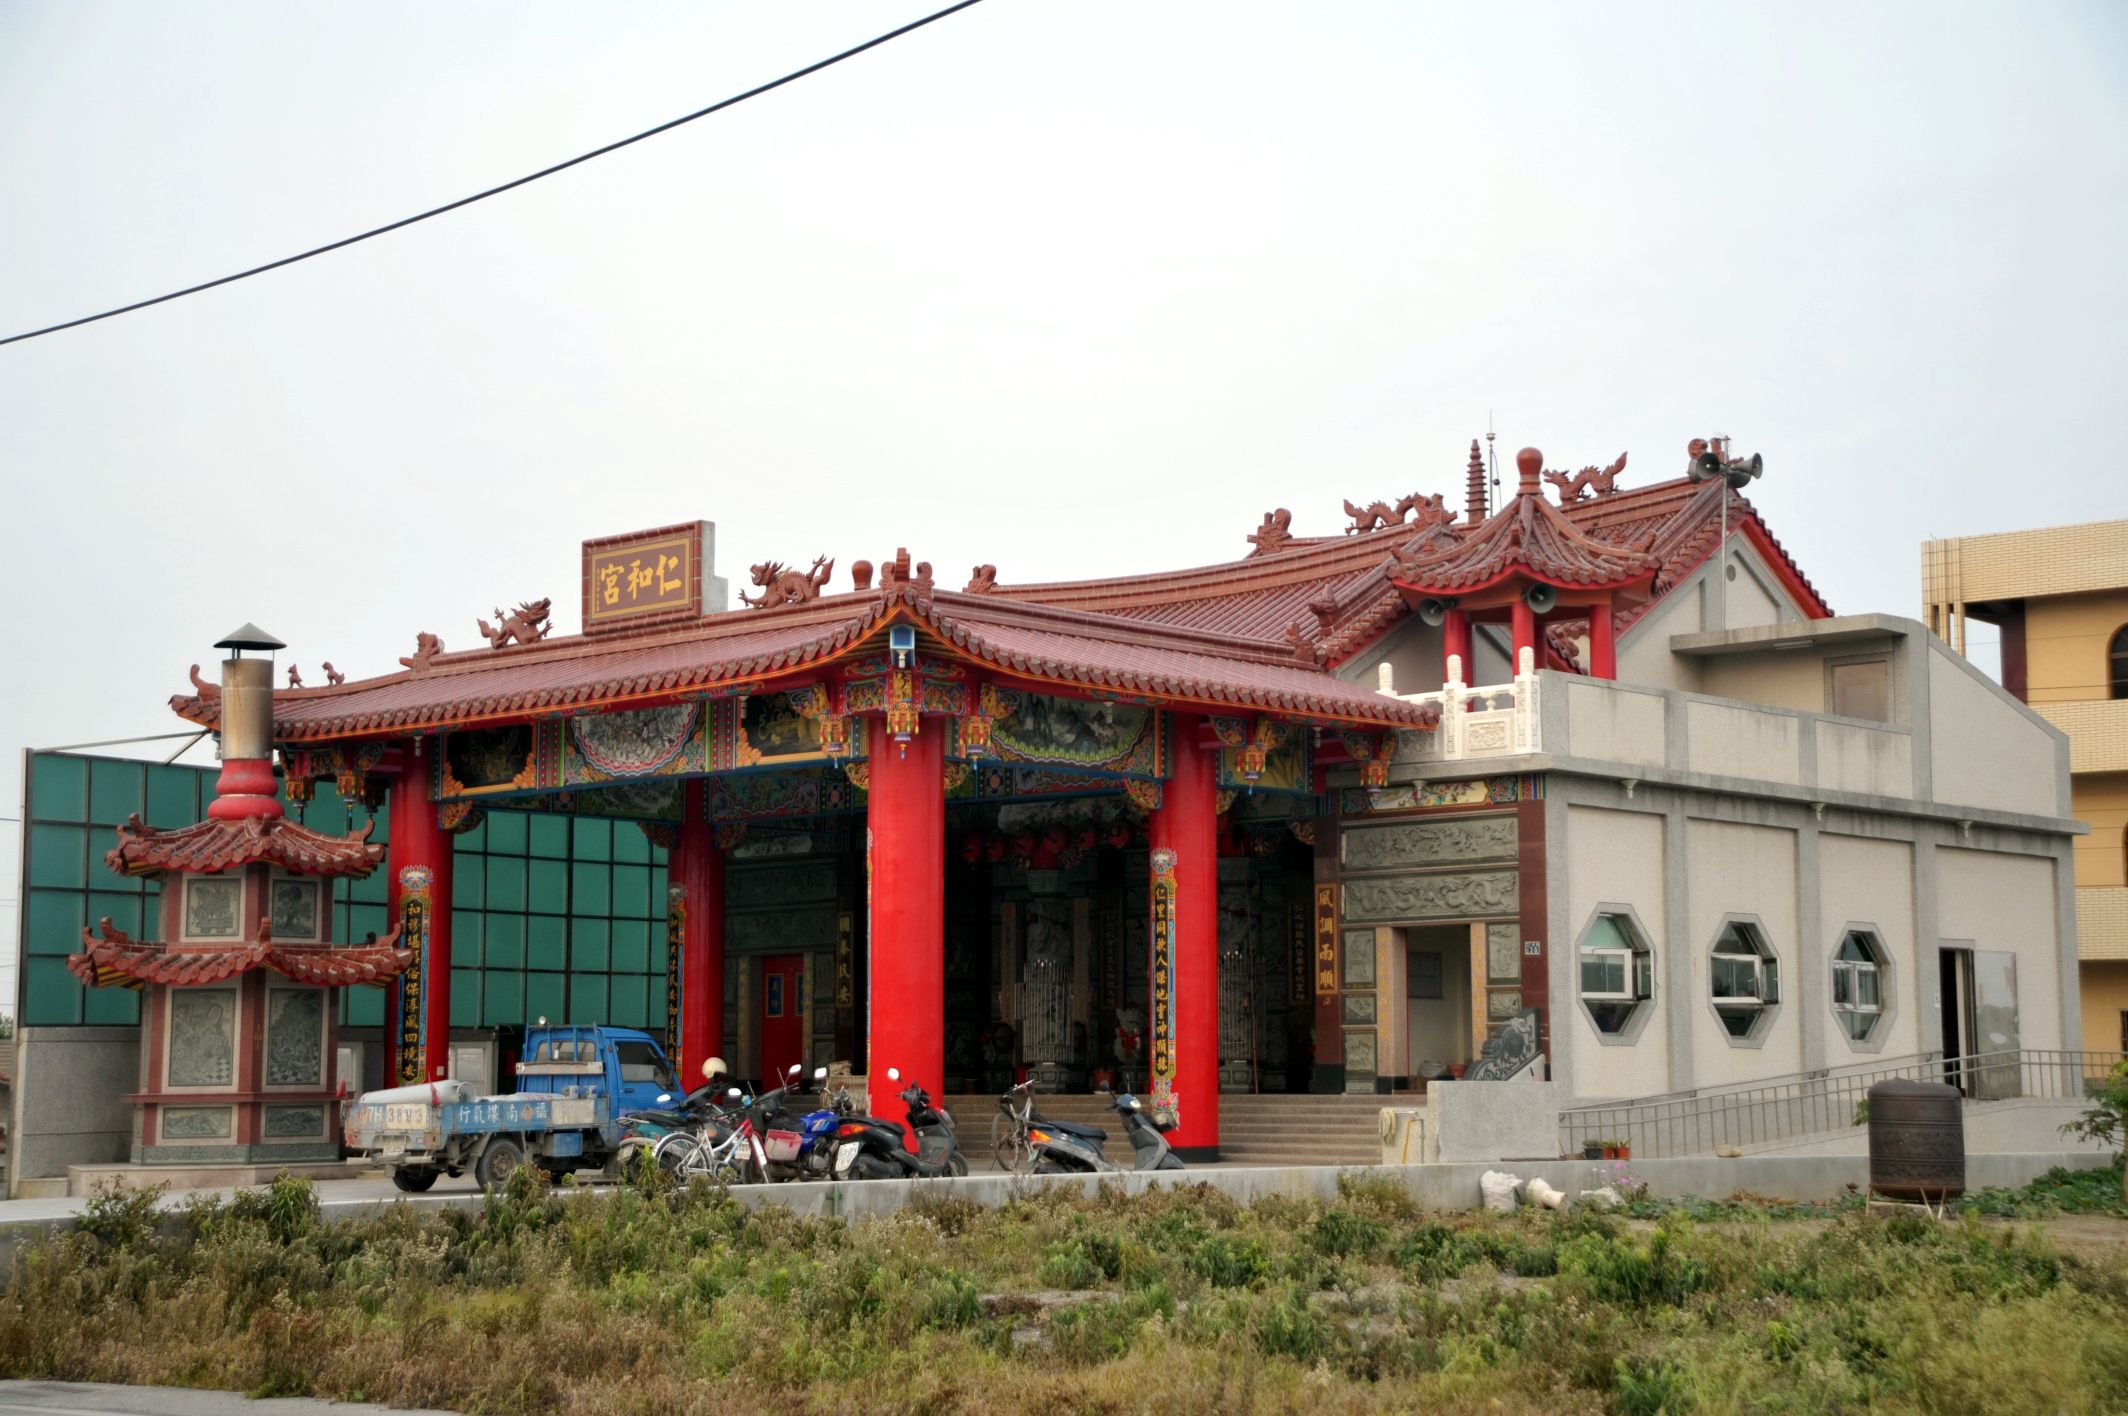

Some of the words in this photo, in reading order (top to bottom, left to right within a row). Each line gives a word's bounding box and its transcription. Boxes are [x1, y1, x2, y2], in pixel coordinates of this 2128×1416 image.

[600, 554, 682, 606] 仁和宮
[838, 916, 851, 1005] 國泰民安
[1318, 889, 1335, 988] 風調雨順
